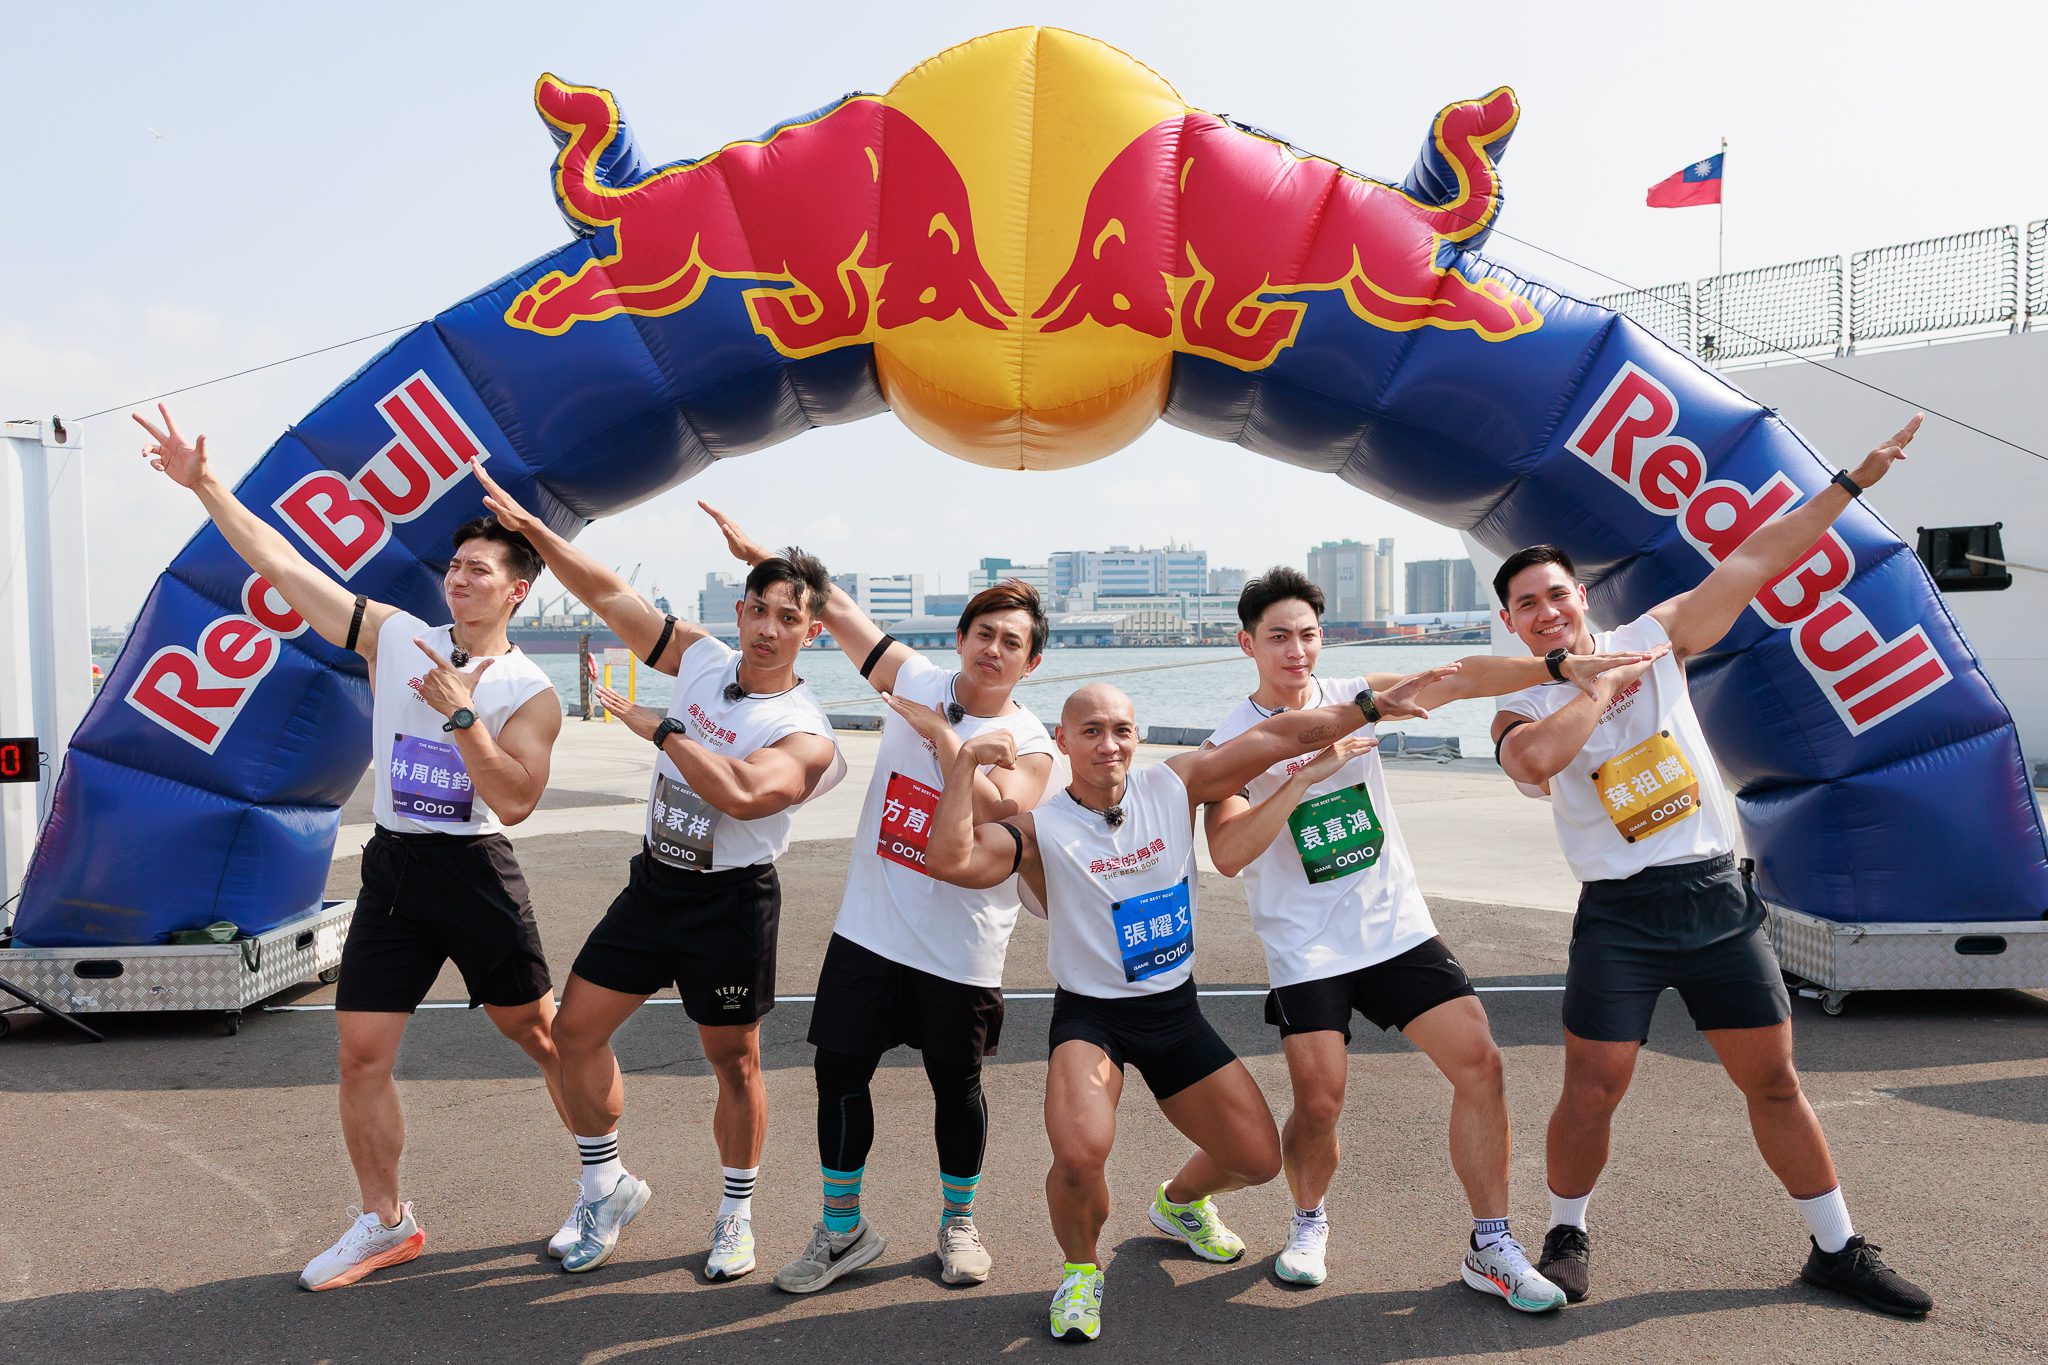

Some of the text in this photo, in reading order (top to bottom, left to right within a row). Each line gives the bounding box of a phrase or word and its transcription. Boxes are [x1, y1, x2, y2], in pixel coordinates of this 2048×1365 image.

[276, 373, 485, 576] Bull
[1570, 365, 1949, 731] Red Bull
[1616, 699, 1635, 714] BODY
[1, 745, 20, 775] 0
[922, 741, 933, 752] THE
[413, 800, 455, 815] 0010
[882, 798, 932, 838] 方育
[1629, 794, 1692, 832] GAME 0010
[1300, 809, 1372, 850] 袁嘉鴻
[659, 842, 697, 862] 0010
[1089, 838, 1166, 873] 最強的身體
[1314, 846, 1375, 874] GAME 0010
[1103, 857, 1160, 880] THE BEST BODY
[1123, 905, 1189, 948] 張耀文
[1133, 942, 1187, 971] GAME 0010
[715, 986, 749, 996] VERVE
[1477, 1221, 1506, 1232] UMA
[1468, 1251, 1524, 1299] HYROX
